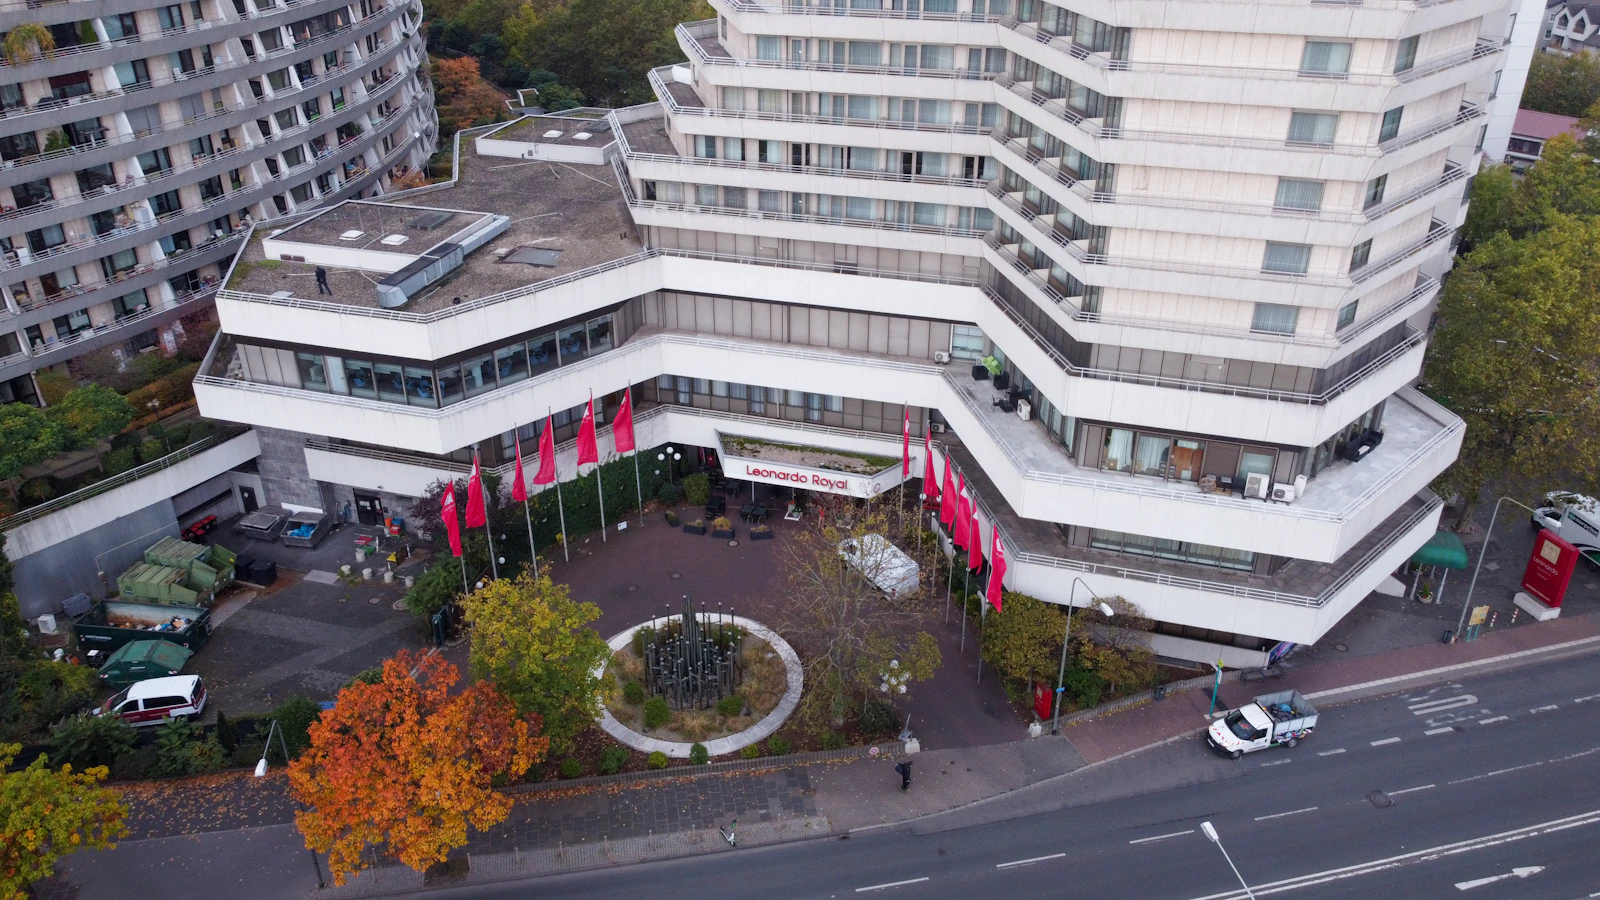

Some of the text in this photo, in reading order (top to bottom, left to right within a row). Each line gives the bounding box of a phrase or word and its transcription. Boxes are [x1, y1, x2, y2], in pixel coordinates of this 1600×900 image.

[746, 464, 848, 490] Leonardo Royal
[1532, 555, 1559, 576] Leonardo
